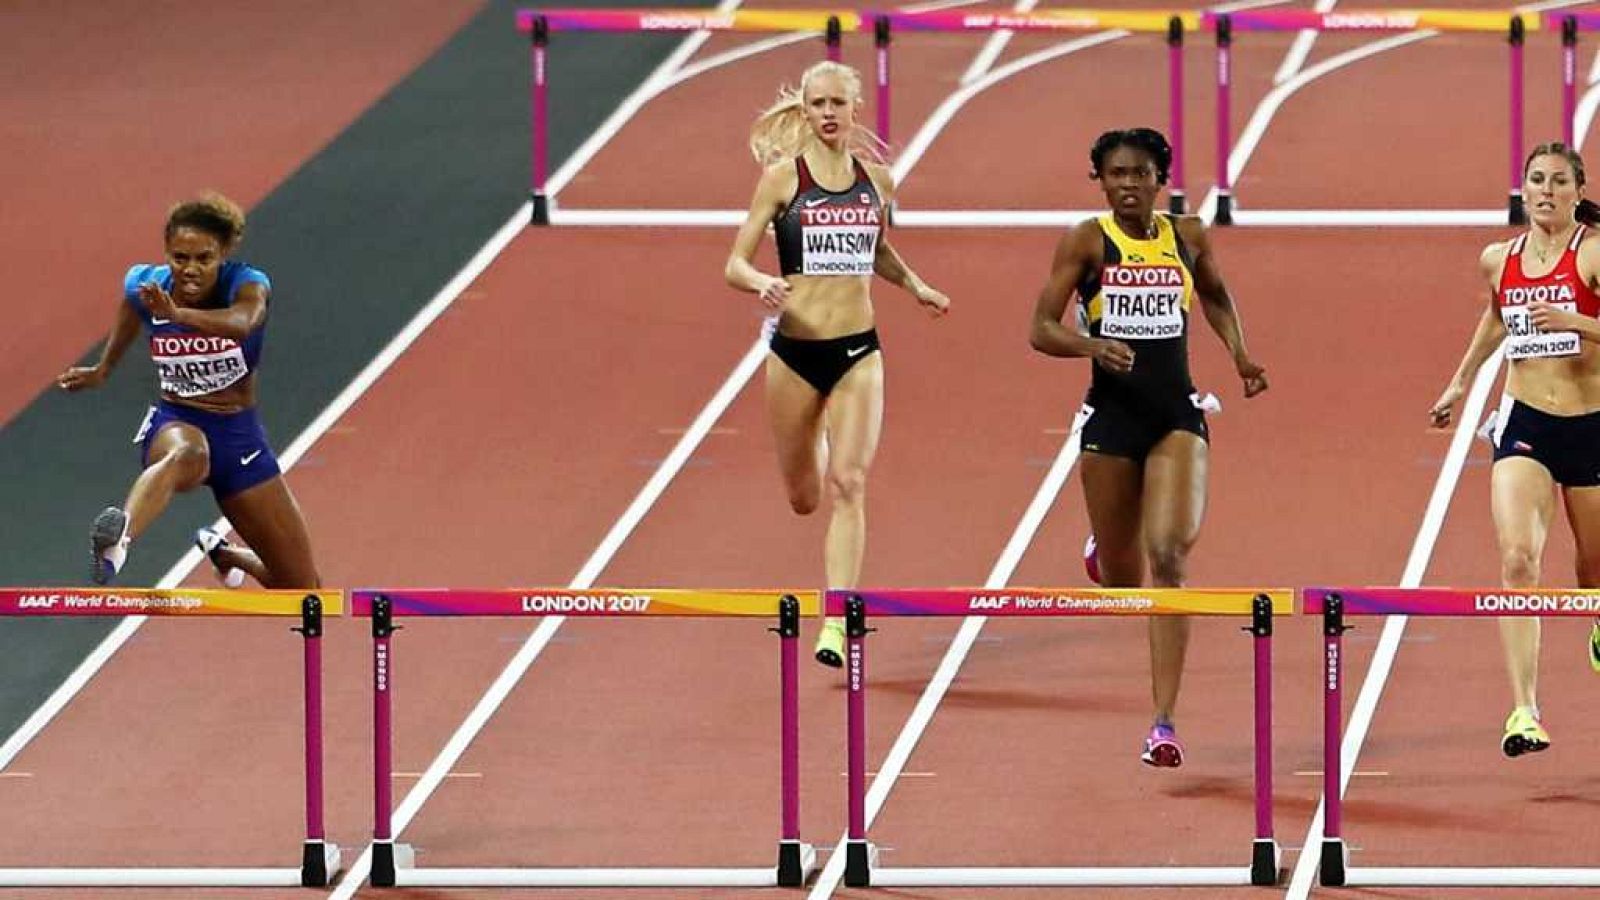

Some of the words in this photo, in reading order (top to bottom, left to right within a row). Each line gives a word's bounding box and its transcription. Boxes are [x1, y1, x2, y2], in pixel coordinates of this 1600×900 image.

[802, 207, 879, 224] TOYOTA
[806, 232, 875, 255] WATSON
[807, 261, 856, 271] LONDON
[1104, 266, 1181, 284] TOYOTA
[1505, 285, 1571, 304] TOYOTA
[1106, 293, 1177, 316] TRACEY
[1104, 322, 1154, 335] LONDON
[1156, 324, 1180, 335] 2017
[152, 336, 238, 353] TOYOTA
[1550, 340, 1575, 352] 2017
[19, 595, 61, 608] IAAF
[63, 596, 101, 607] World
[106, 594, 202, 609] Championships
[522, 596, 604, 612] LONDON
[607, 595, 651, 612] 2017
[970, 596, 1012, 609] IAAF
[1015, 596, 1053, 608] World
[1057, 594, 1153, 610] Championships
[1475, 594, 1557, 611] LONDON
[1560, 595, 1600, 611] 2017
